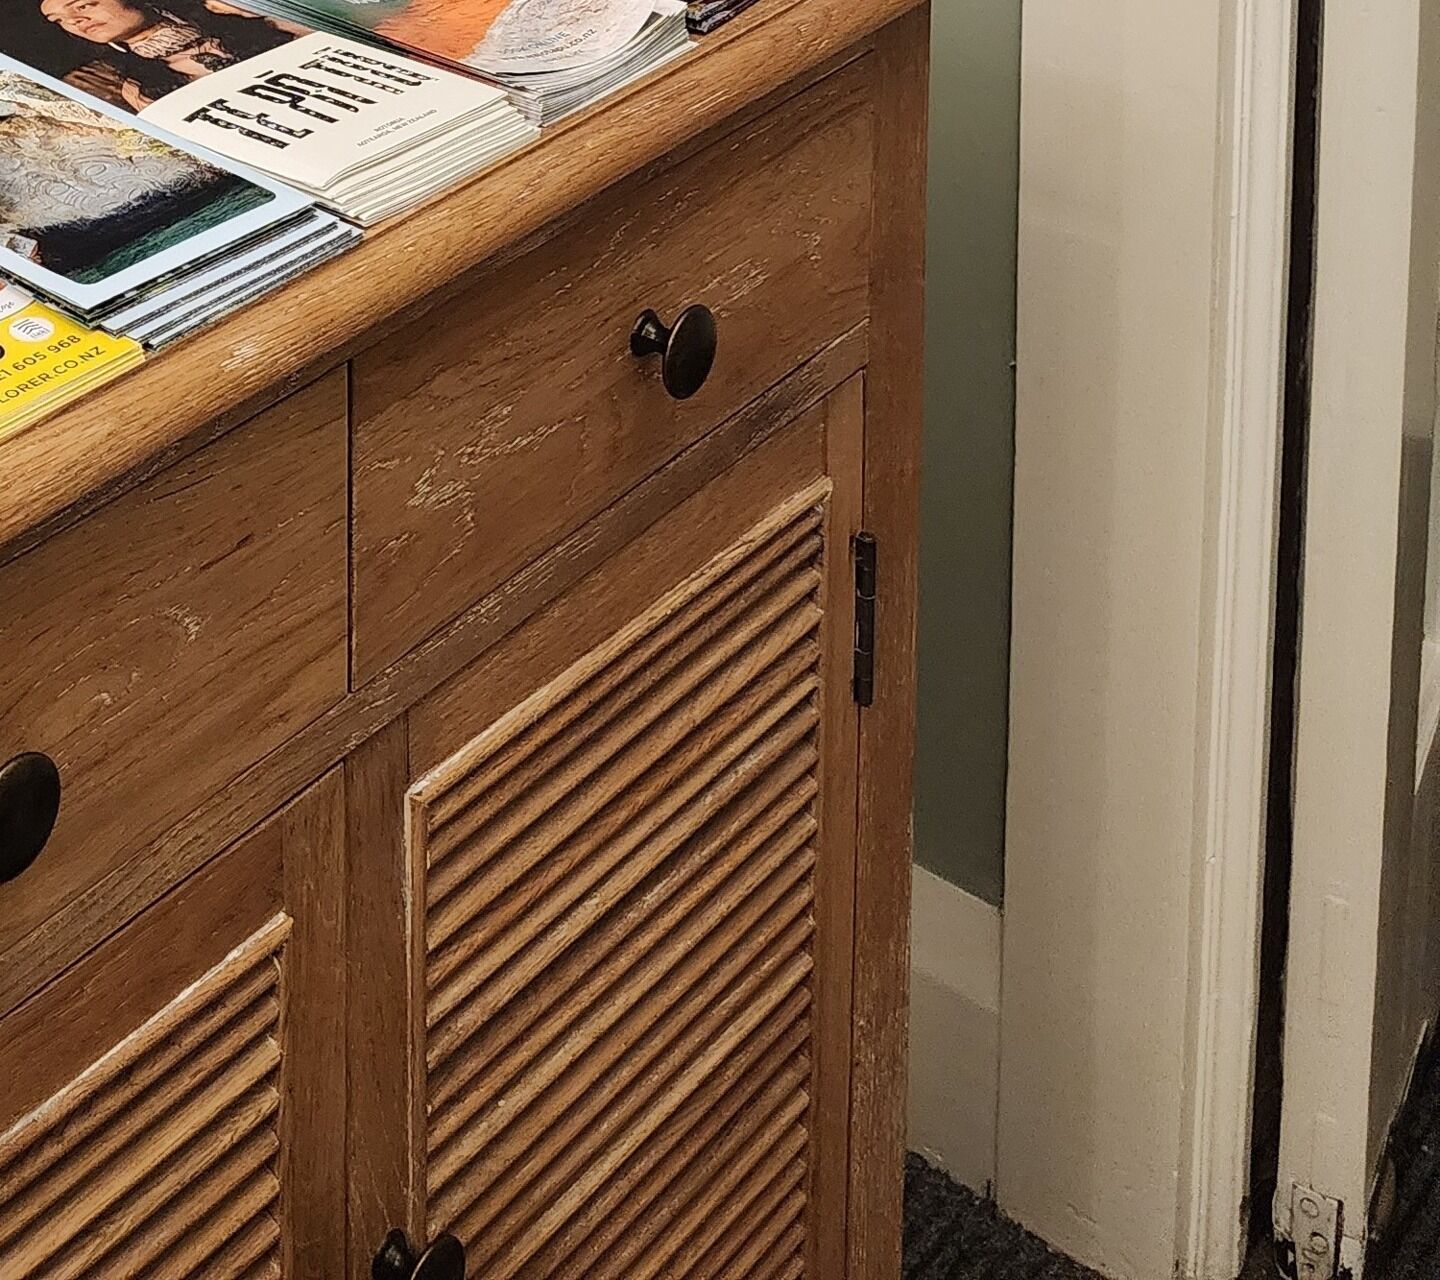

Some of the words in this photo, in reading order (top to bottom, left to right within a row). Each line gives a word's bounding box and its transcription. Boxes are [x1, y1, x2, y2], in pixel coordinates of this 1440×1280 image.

[184, 98, 312, 148] TE
[12, 351, 47, 371] 605
[47, 335, 81, 353] 968
